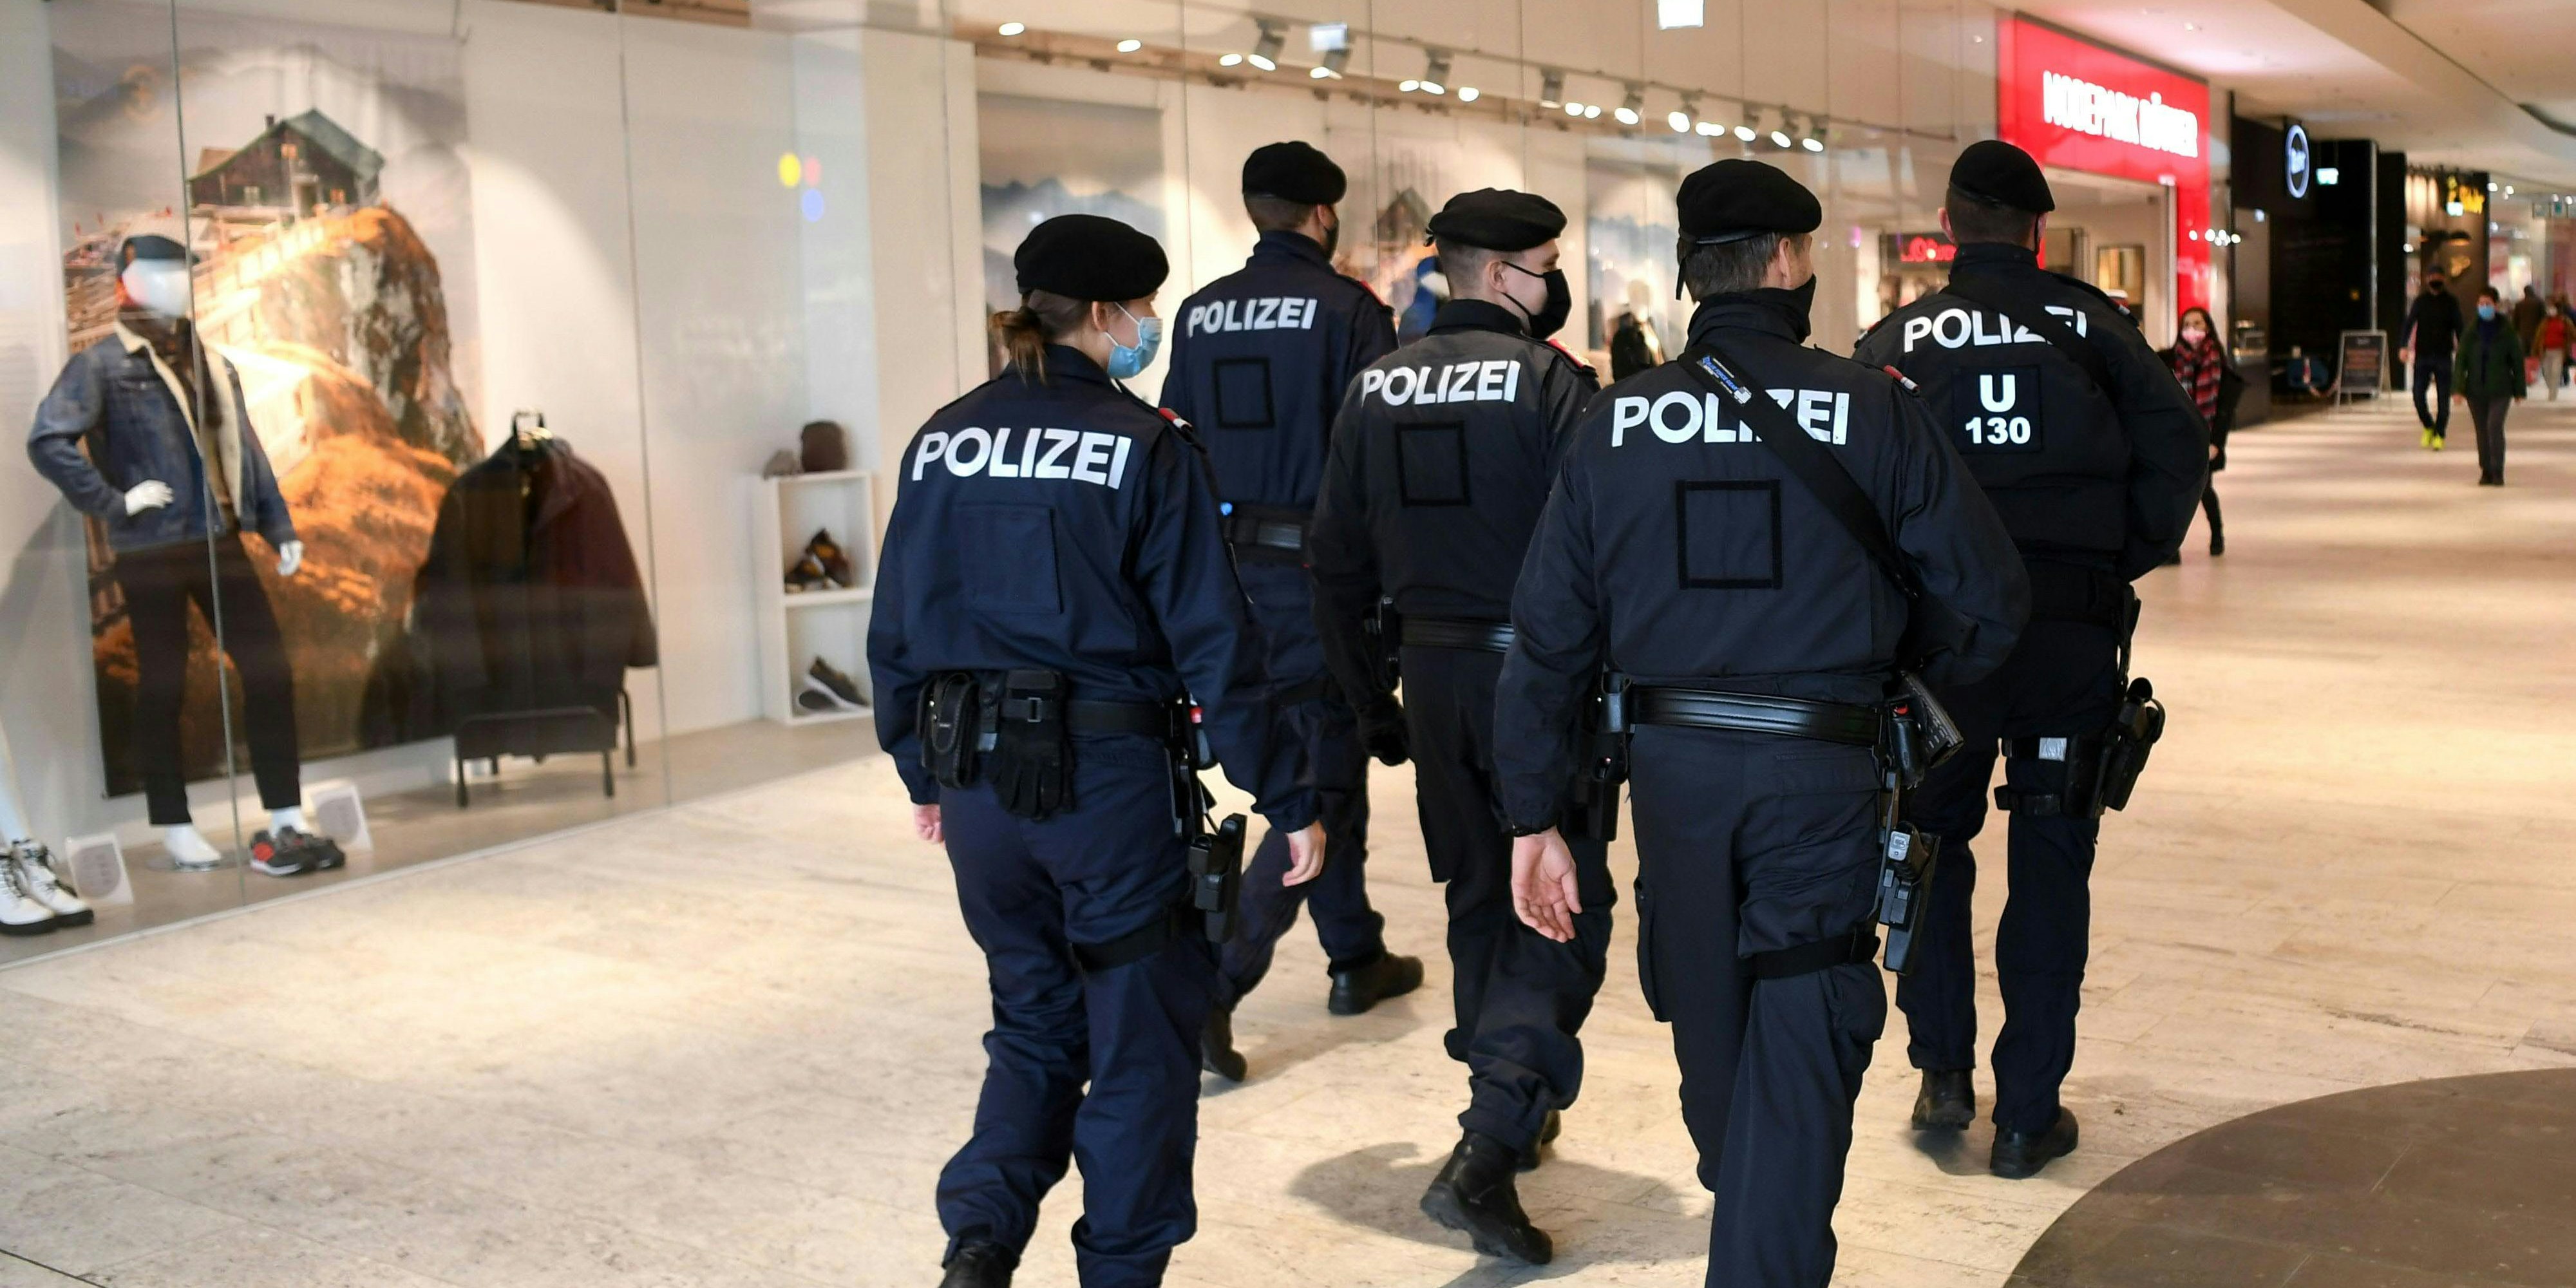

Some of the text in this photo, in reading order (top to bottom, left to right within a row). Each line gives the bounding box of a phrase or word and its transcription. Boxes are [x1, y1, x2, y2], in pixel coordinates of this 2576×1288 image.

[2139, 91, 2198, 158] RÖER
[1187, 296, 1318, 339] POLIZEI
[1361, 359, 1521, 408] POLIZEI
[1979, 374, 2016, 412] U
[1611, 389, 1850, 448] POLEI
[1965, 417, 2031, 444] 130
[912, 426, 1132, 490] POLIZEI
